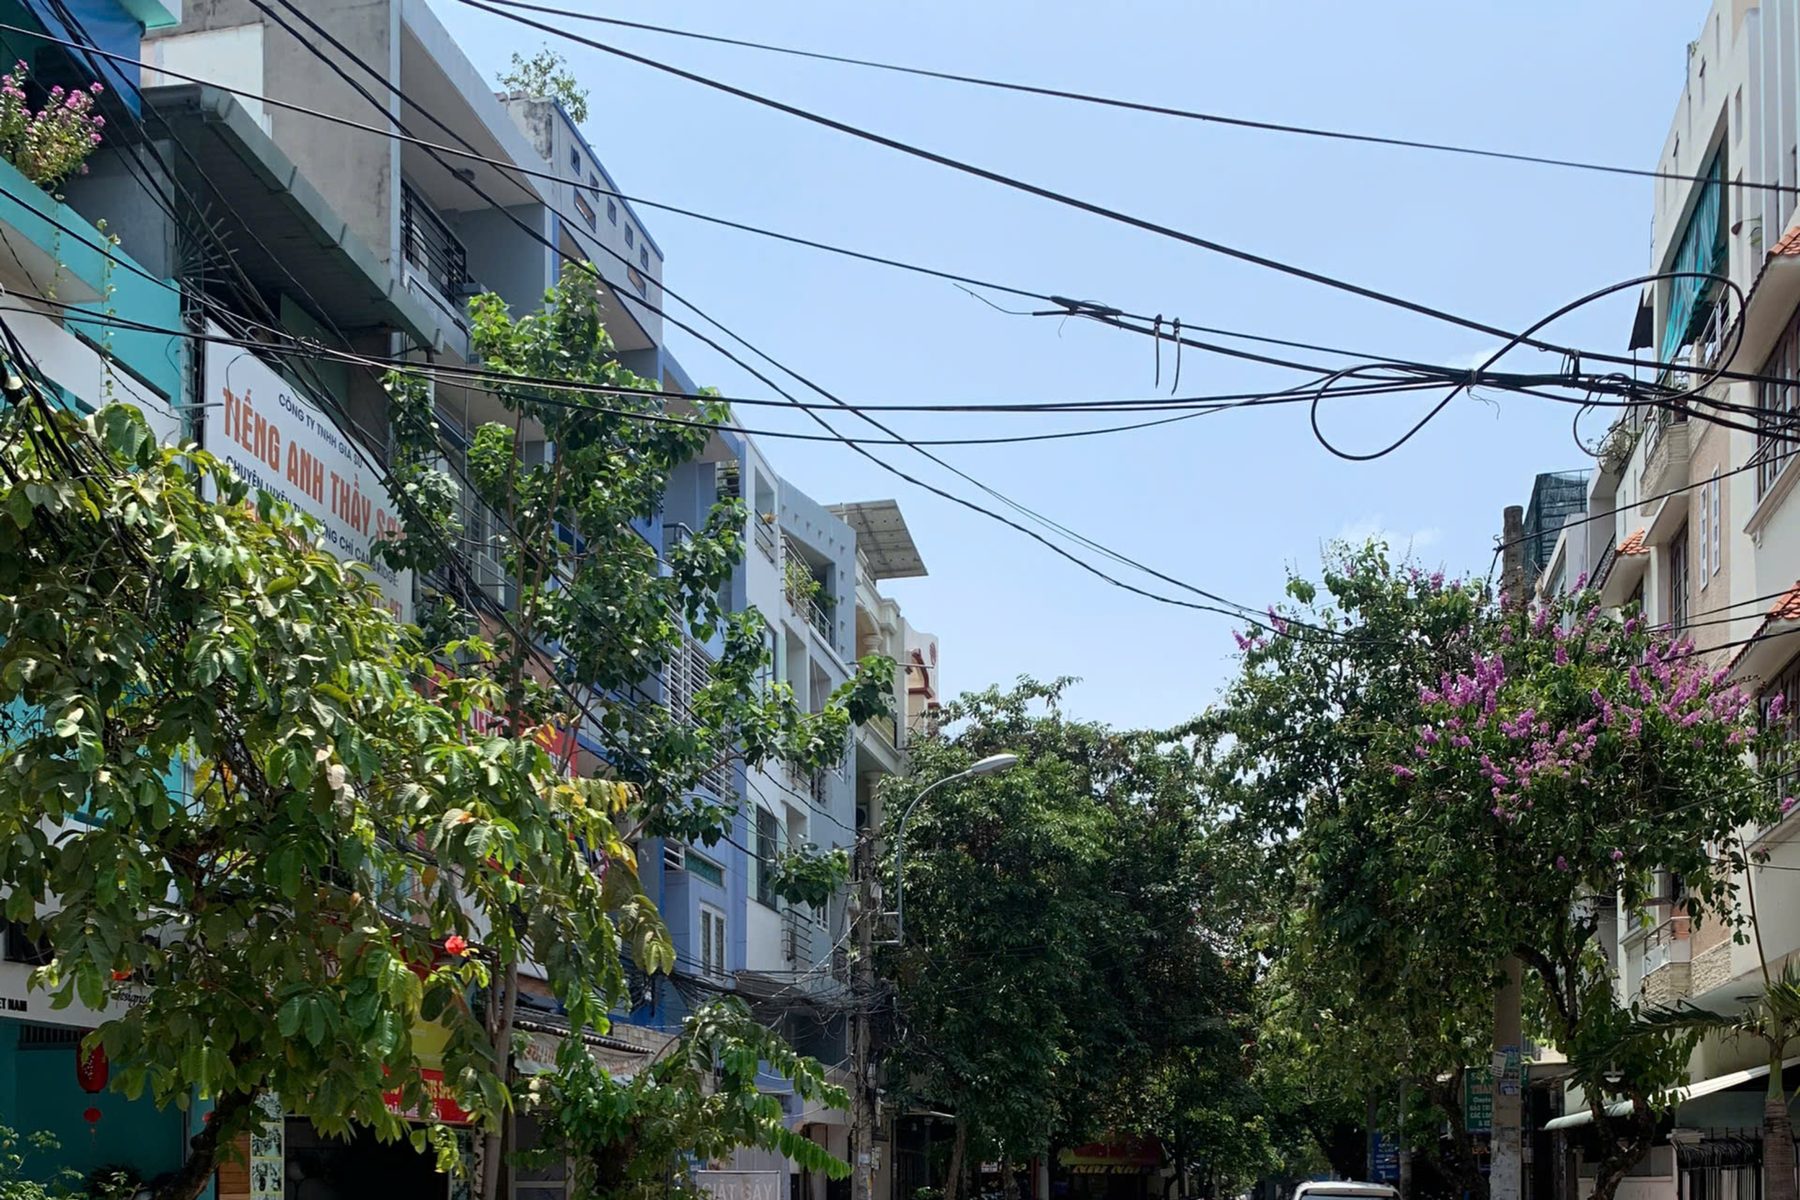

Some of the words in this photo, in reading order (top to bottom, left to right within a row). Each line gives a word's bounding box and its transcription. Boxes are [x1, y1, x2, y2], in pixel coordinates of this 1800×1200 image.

[278, 393, 305, 422] CÔNG
[306, 414, 316, 430] TY
[316, 423, 337, 448] TNHH
[338, 441, 352, 461] GIA
[223, 387, 281, 474] TIẾNG
[286, 440, 324, 504] ANH
[330, 471, 372, 537] THẦY
[7, 998, 28, 1012] NAM
